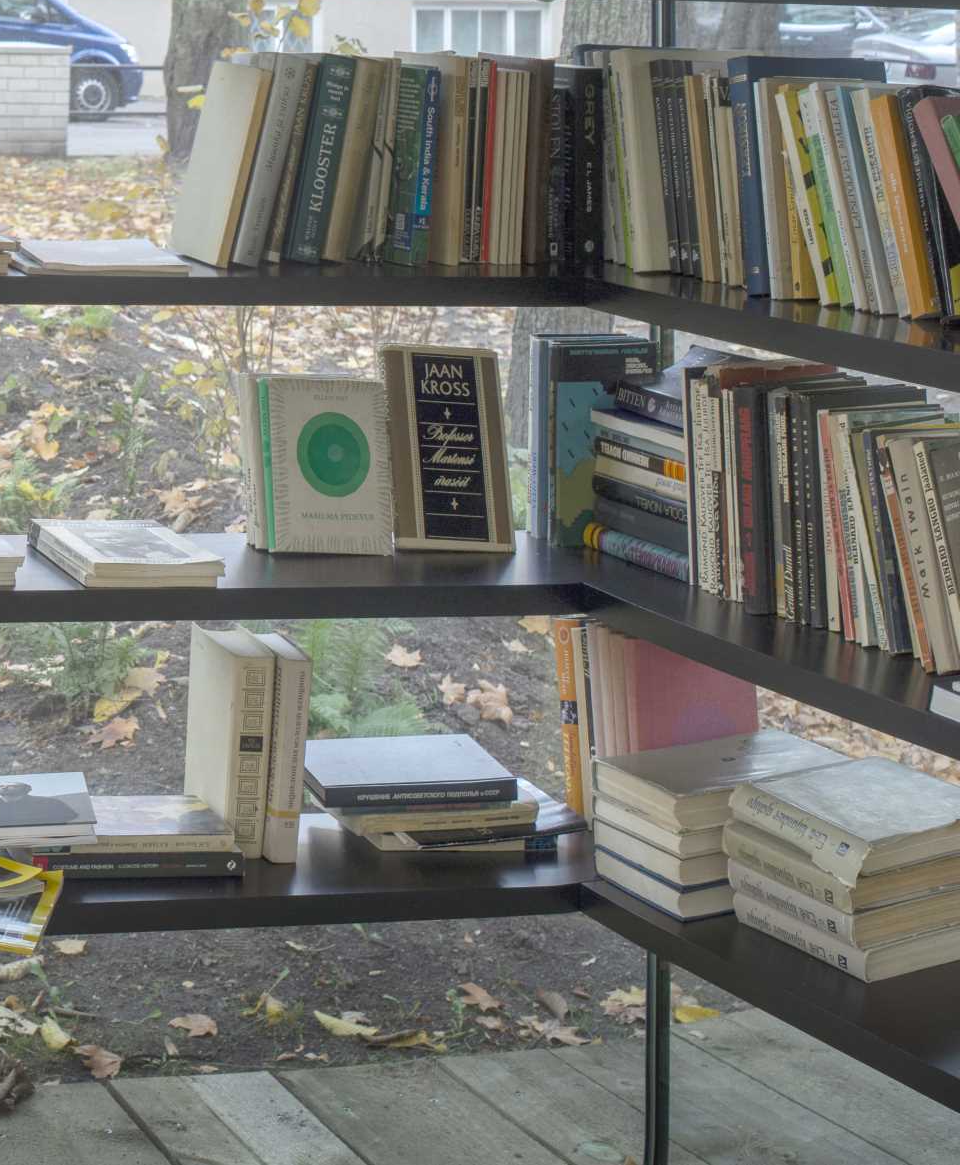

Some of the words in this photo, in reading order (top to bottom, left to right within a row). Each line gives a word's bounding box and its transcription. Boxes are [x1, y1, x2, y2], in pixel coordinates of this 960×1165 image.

[424, 106, 436, 138] South
[551, 93, 561, 159] STOLEN
[585, 84, 595, 144] GREY
[309, 123, 337, 212] KLOOSTER
[418, 177, 430, 211] Kerala
[421, 379, 470, 397] KROSS
[425, 363, 463, 379] JAAN
[616, 387, 646, 408] BITTEN
[897, 472, 920, 535] Twain
[924, 496, 944, 541] KANGRO
[782, 543, 794, 582] Durrell
[911, 544, 932, 599] Mark
[935, 544, 957, 595] BERNARD
